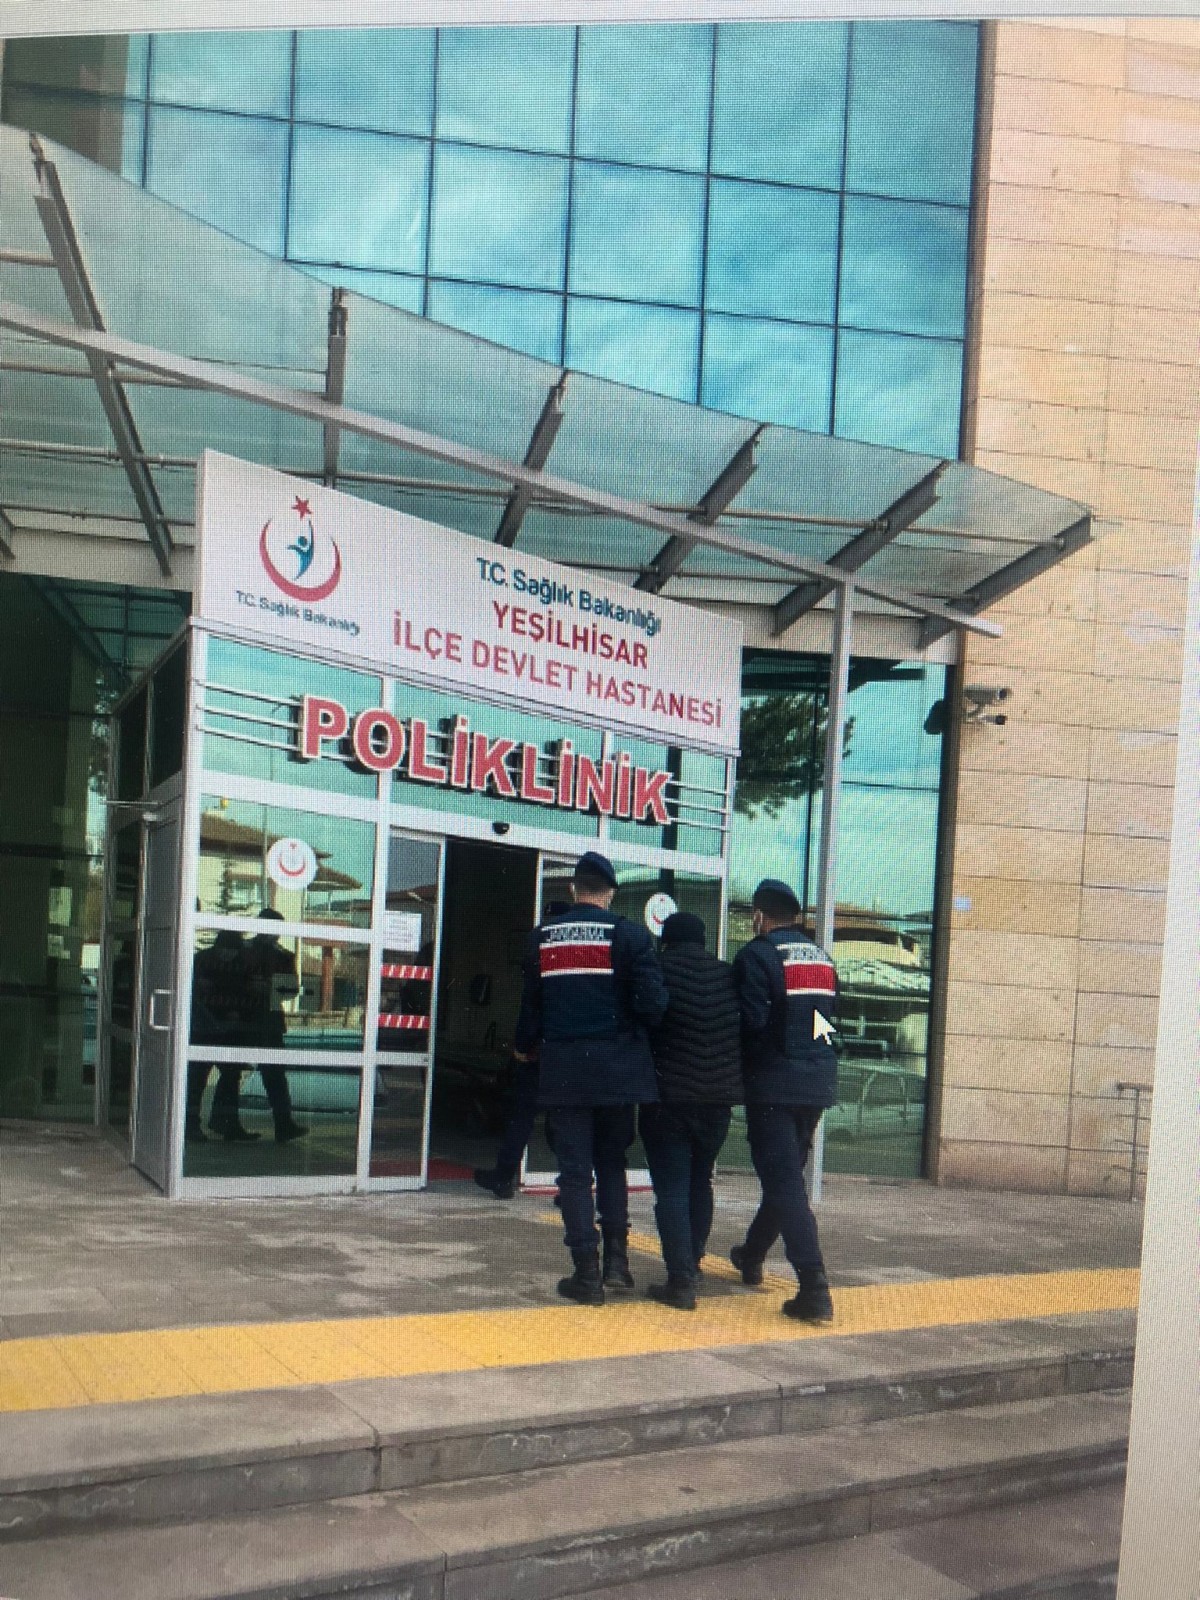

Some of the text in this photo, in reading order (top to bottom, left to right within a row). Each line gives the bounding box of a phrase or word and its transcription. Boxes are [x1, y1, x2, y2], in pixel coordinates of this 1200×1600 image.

[476, 557, 662, 637] T.C. Sağlık Bakanlığı
[492, 600, 649, 669] YEŞİLHİSAR
[393, 610, 722, 728] İLÇE DEVLET HASTANESİ
[301, 694, 674, 825] POLİKLİNİK
